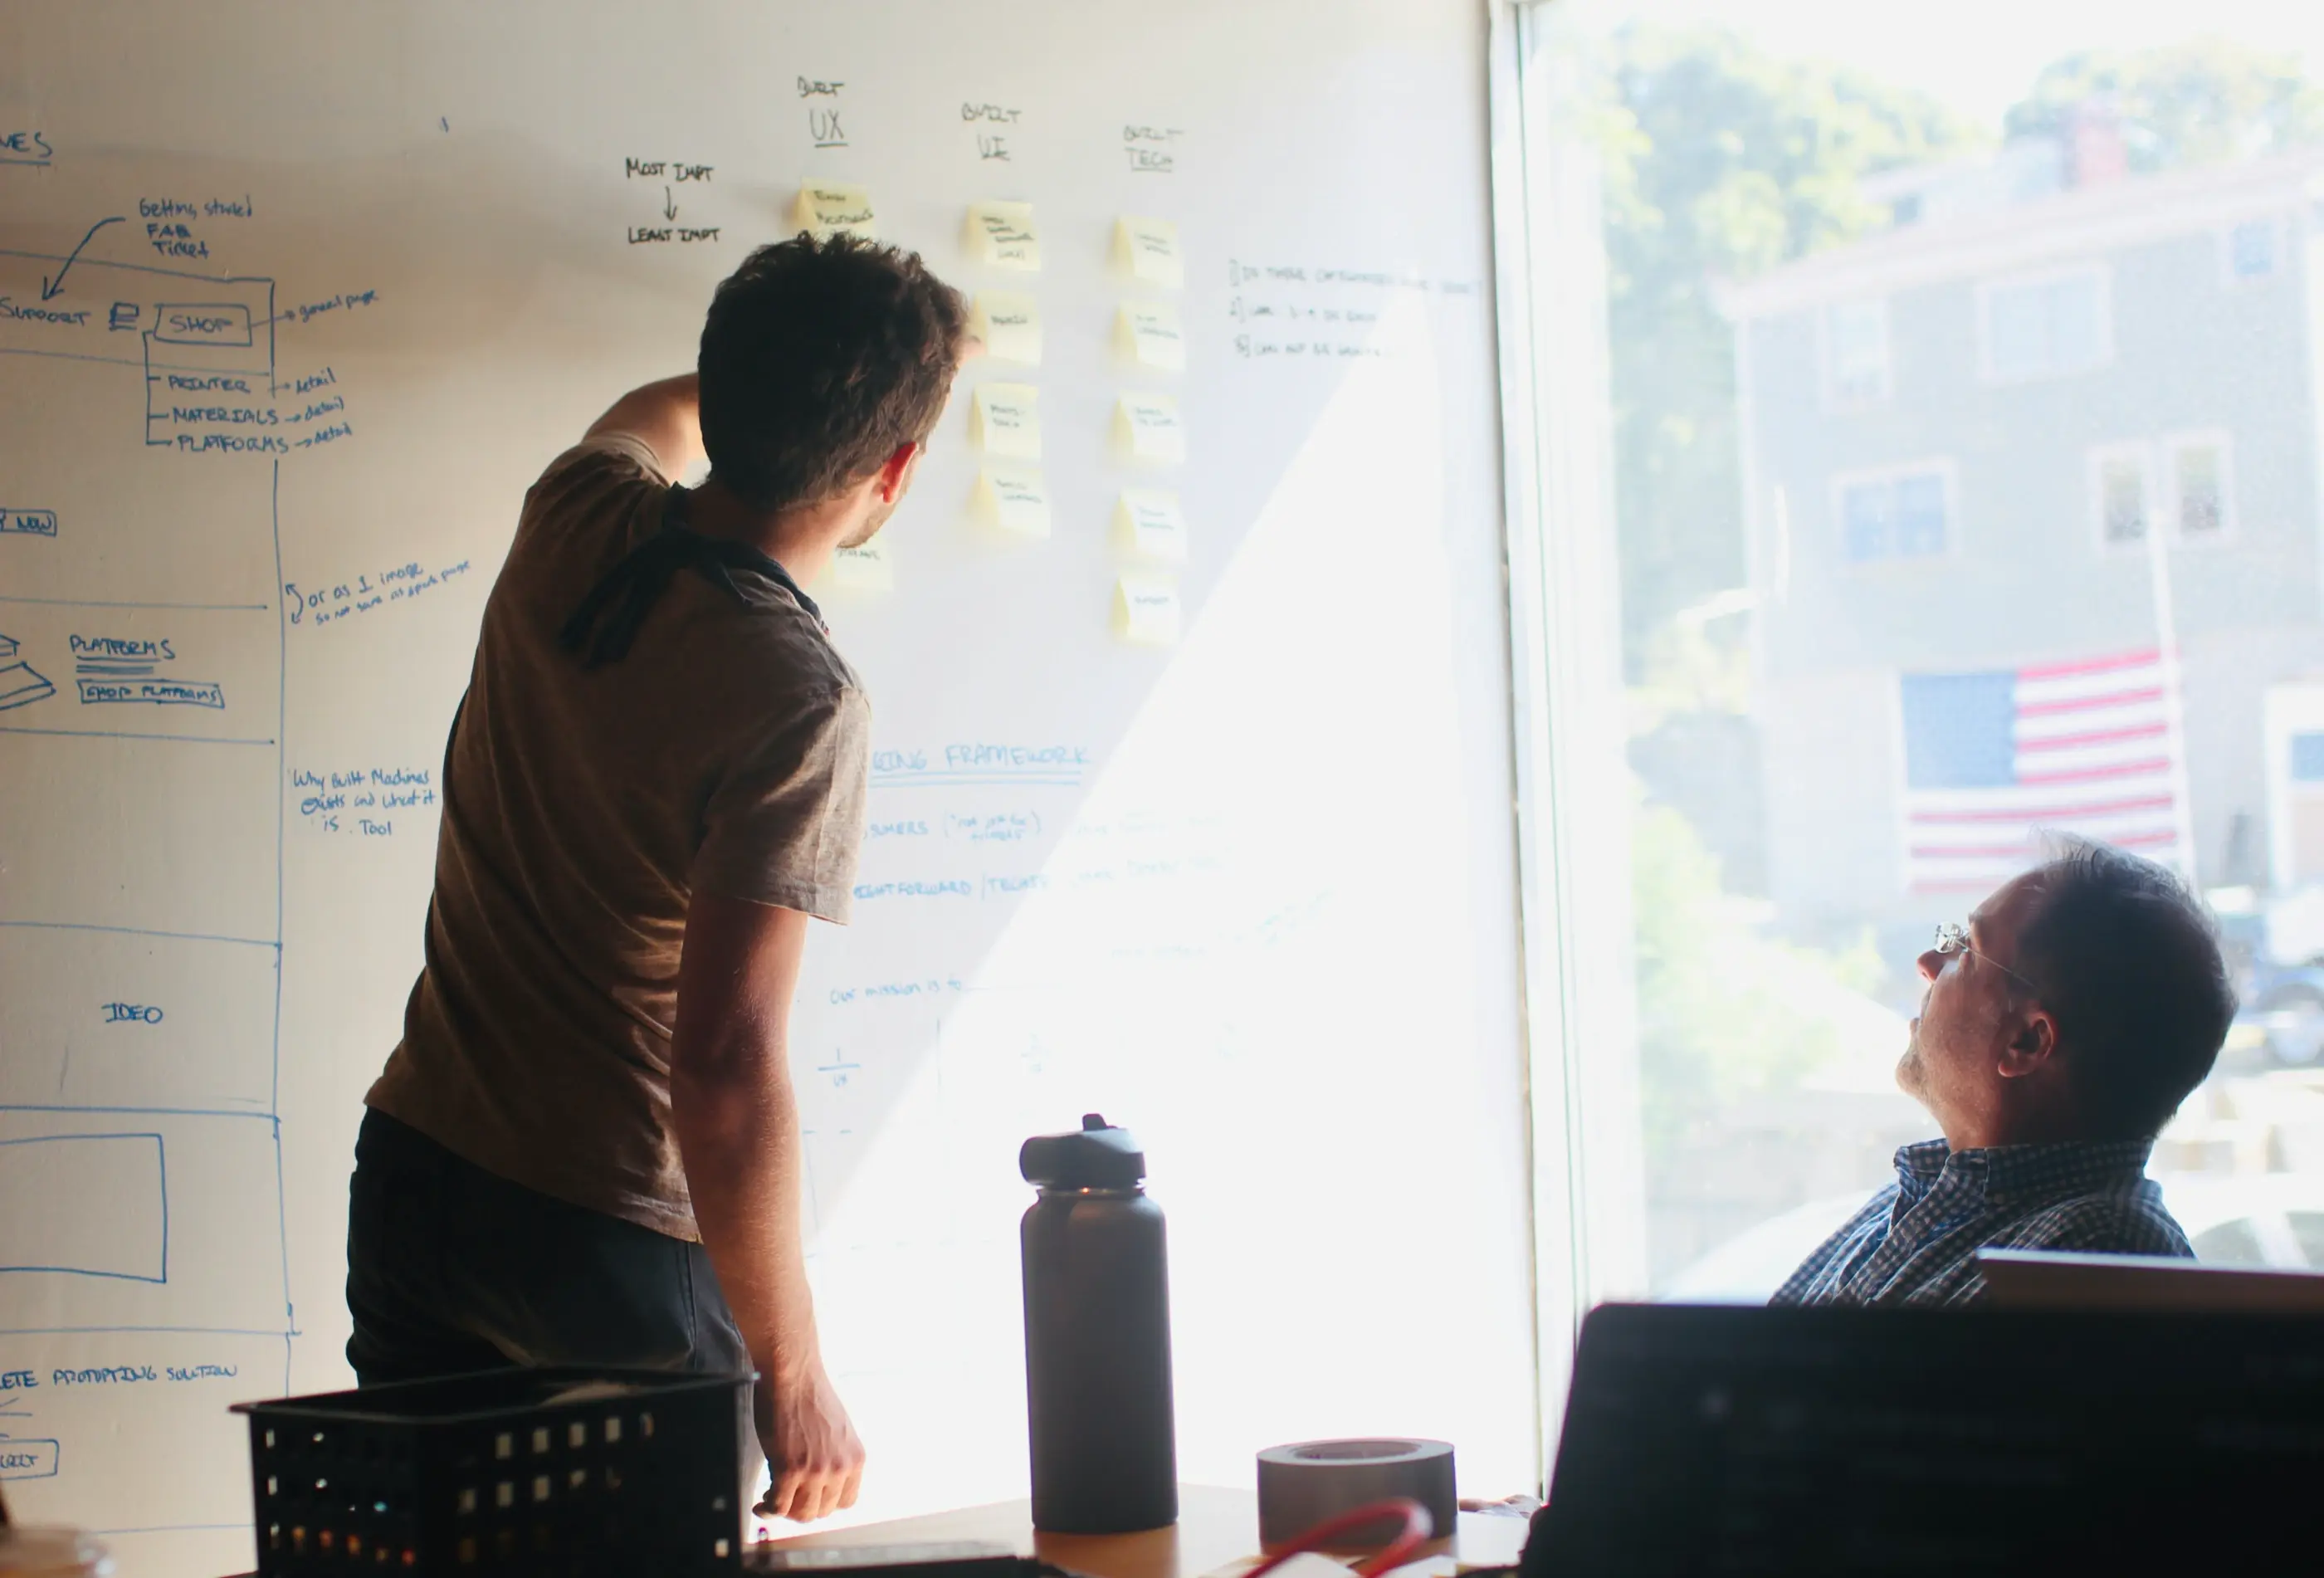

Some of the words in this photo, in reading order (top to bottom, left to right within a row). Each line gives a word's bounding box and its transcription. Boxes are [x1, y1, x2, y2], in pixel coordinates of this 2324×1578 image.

[809, 109, 844, 140] UX
[626, 156, 666, 179] MOST
[139, 197, 198, 221] Getting
[628, 226, 674, 244] LEAST
[169, 314, 233, 333] SHOP
[173, 406, 280, 426] MATERIALS
[177, 433, 289, 455] PLATFORMS
[308, 588, 325, 608] or
[333, 583, 351, 600] as
[69, 634, 176, 660] PLATFORMS
[944, 743, 1094, 769] FRAMEWORK
[293, 769, 326, 798] Why
[100, 1002, 164, 1024] IDEO
[0, 1370, 40, 1390] ETE
